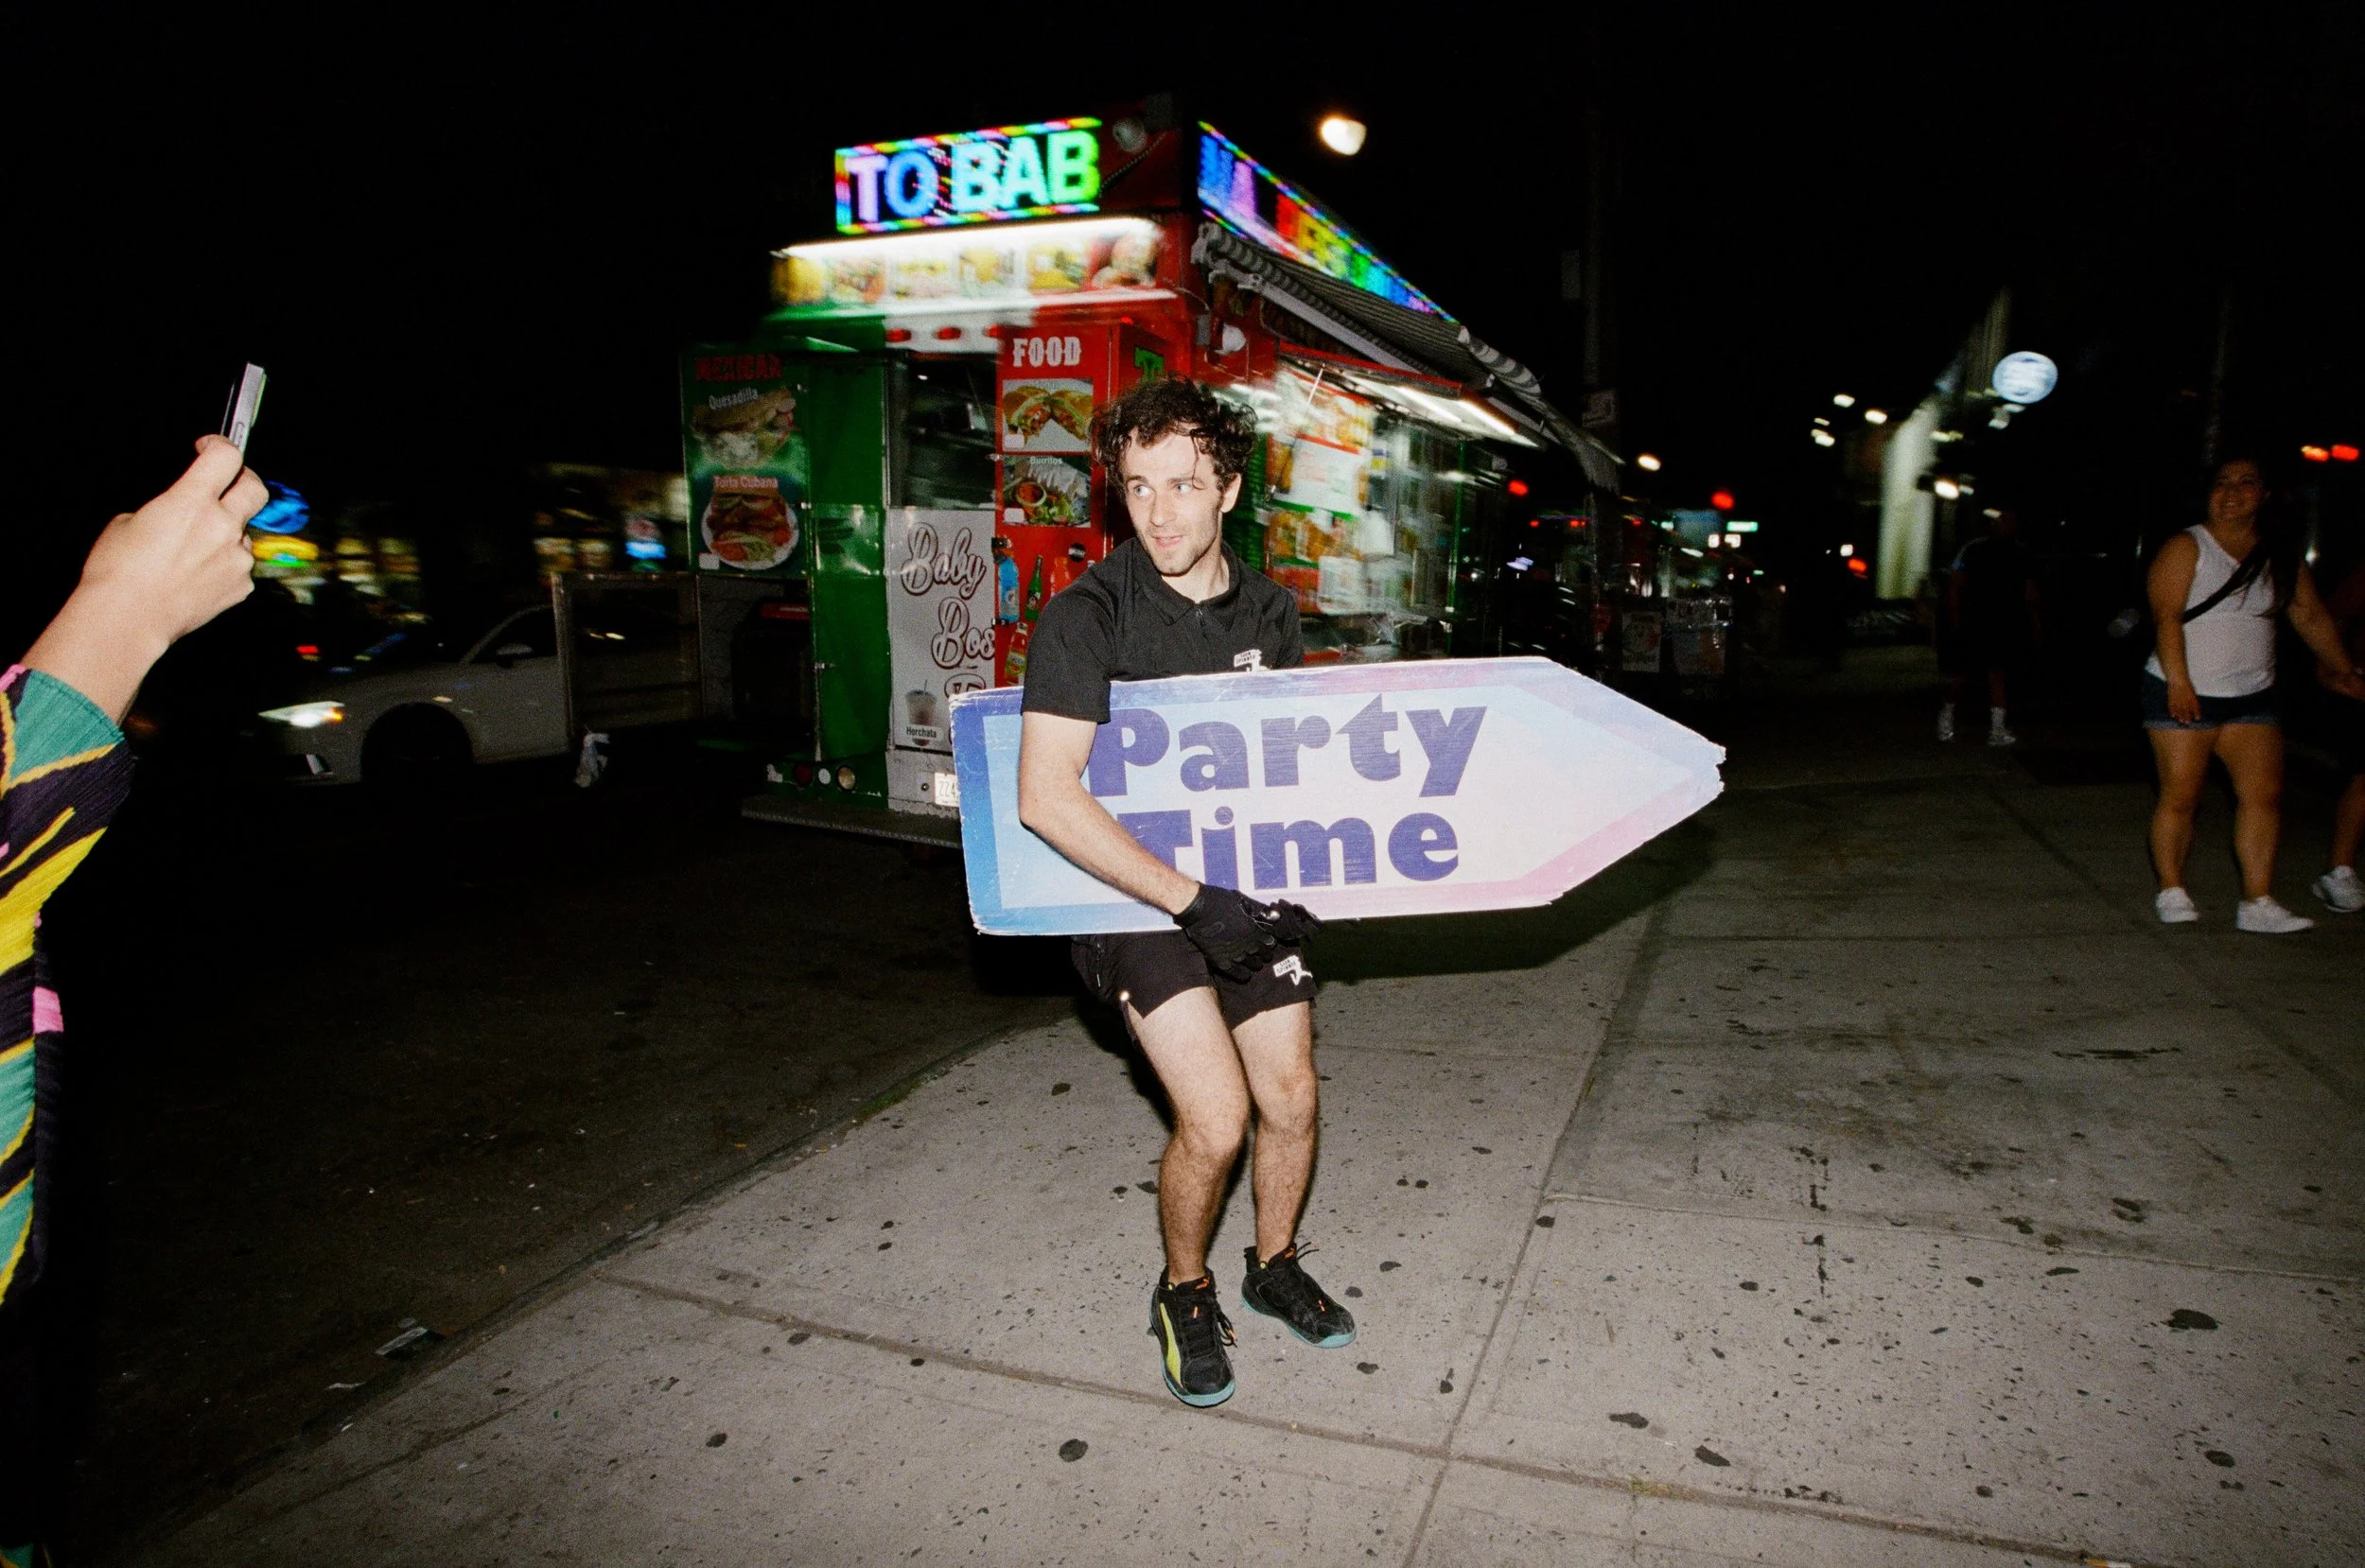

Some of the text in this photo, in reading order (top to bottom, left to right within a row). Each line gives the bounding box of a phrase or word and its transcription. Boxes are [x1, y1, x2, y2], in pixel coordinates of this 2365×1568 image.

[845, 130, 1100, 224] TO BAB
[1012, 336, 1082, 368] FOOD
[901, 521, 987, 601] Baby
[905, 724, 937, 739] Horchata
[1086, 693, 1487, 797] Party
[1116, 806, 1459, 891] Time
